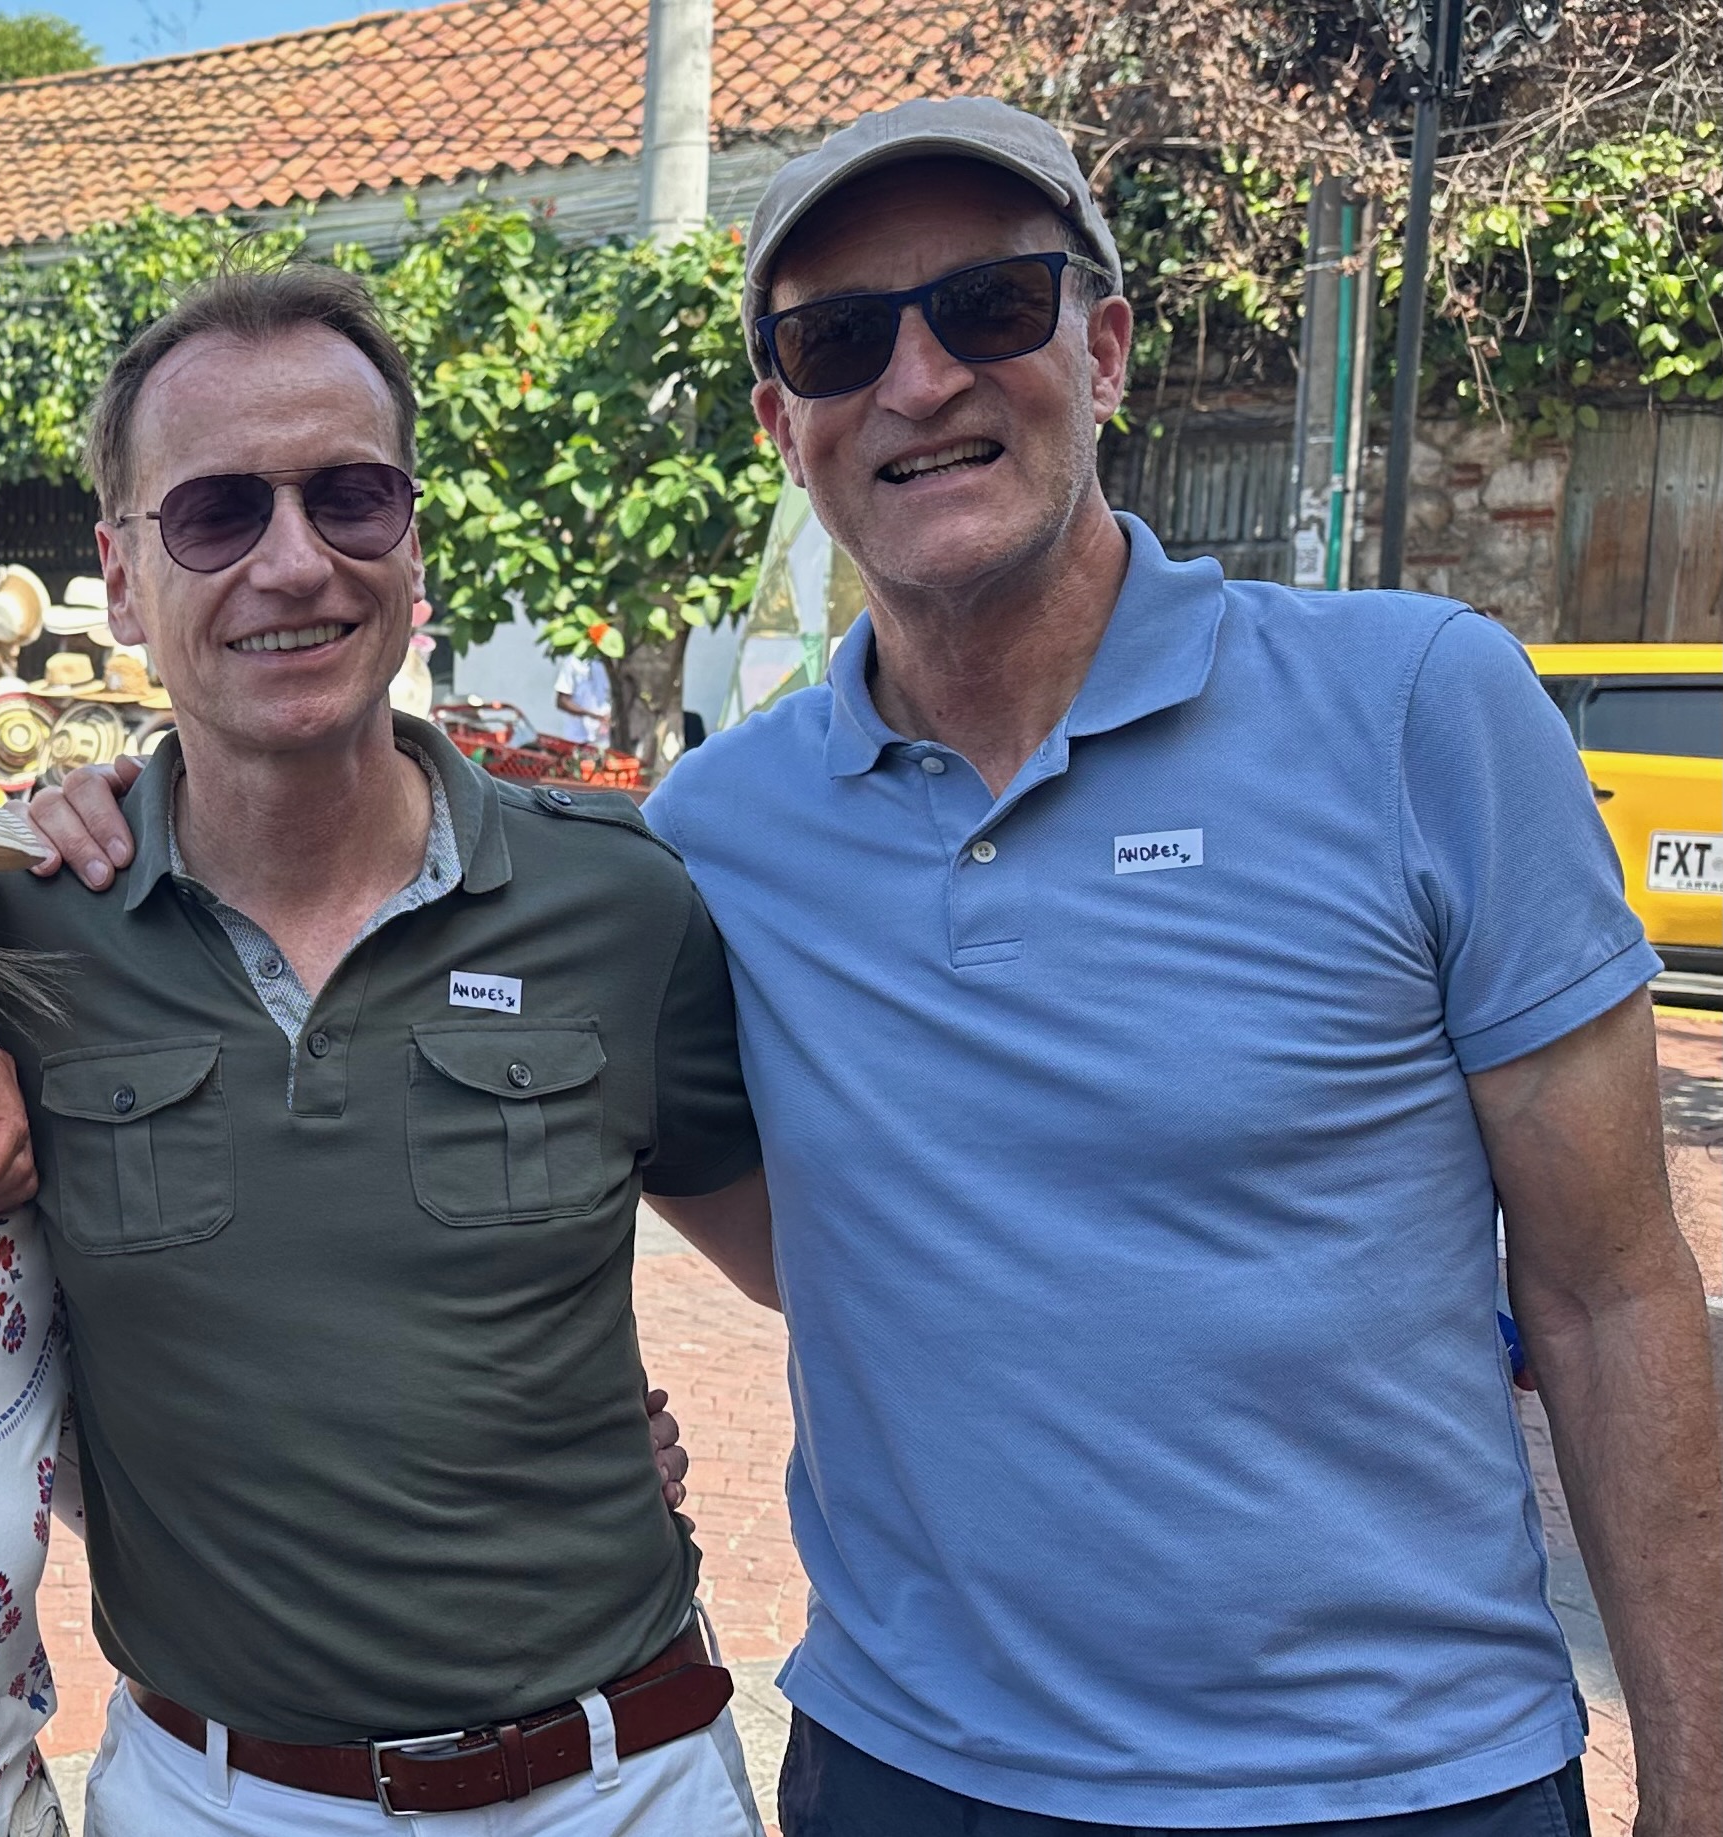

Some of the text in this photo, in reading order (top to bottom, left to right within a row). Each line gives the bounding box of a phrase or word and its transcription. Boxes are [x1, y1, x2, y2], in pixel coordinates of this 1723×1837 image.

[1118, 844, 1180, 863] ANDRES
[1654, 841, 1712, 878] FXT
[453, 982, 505, 1001] ANDRES
